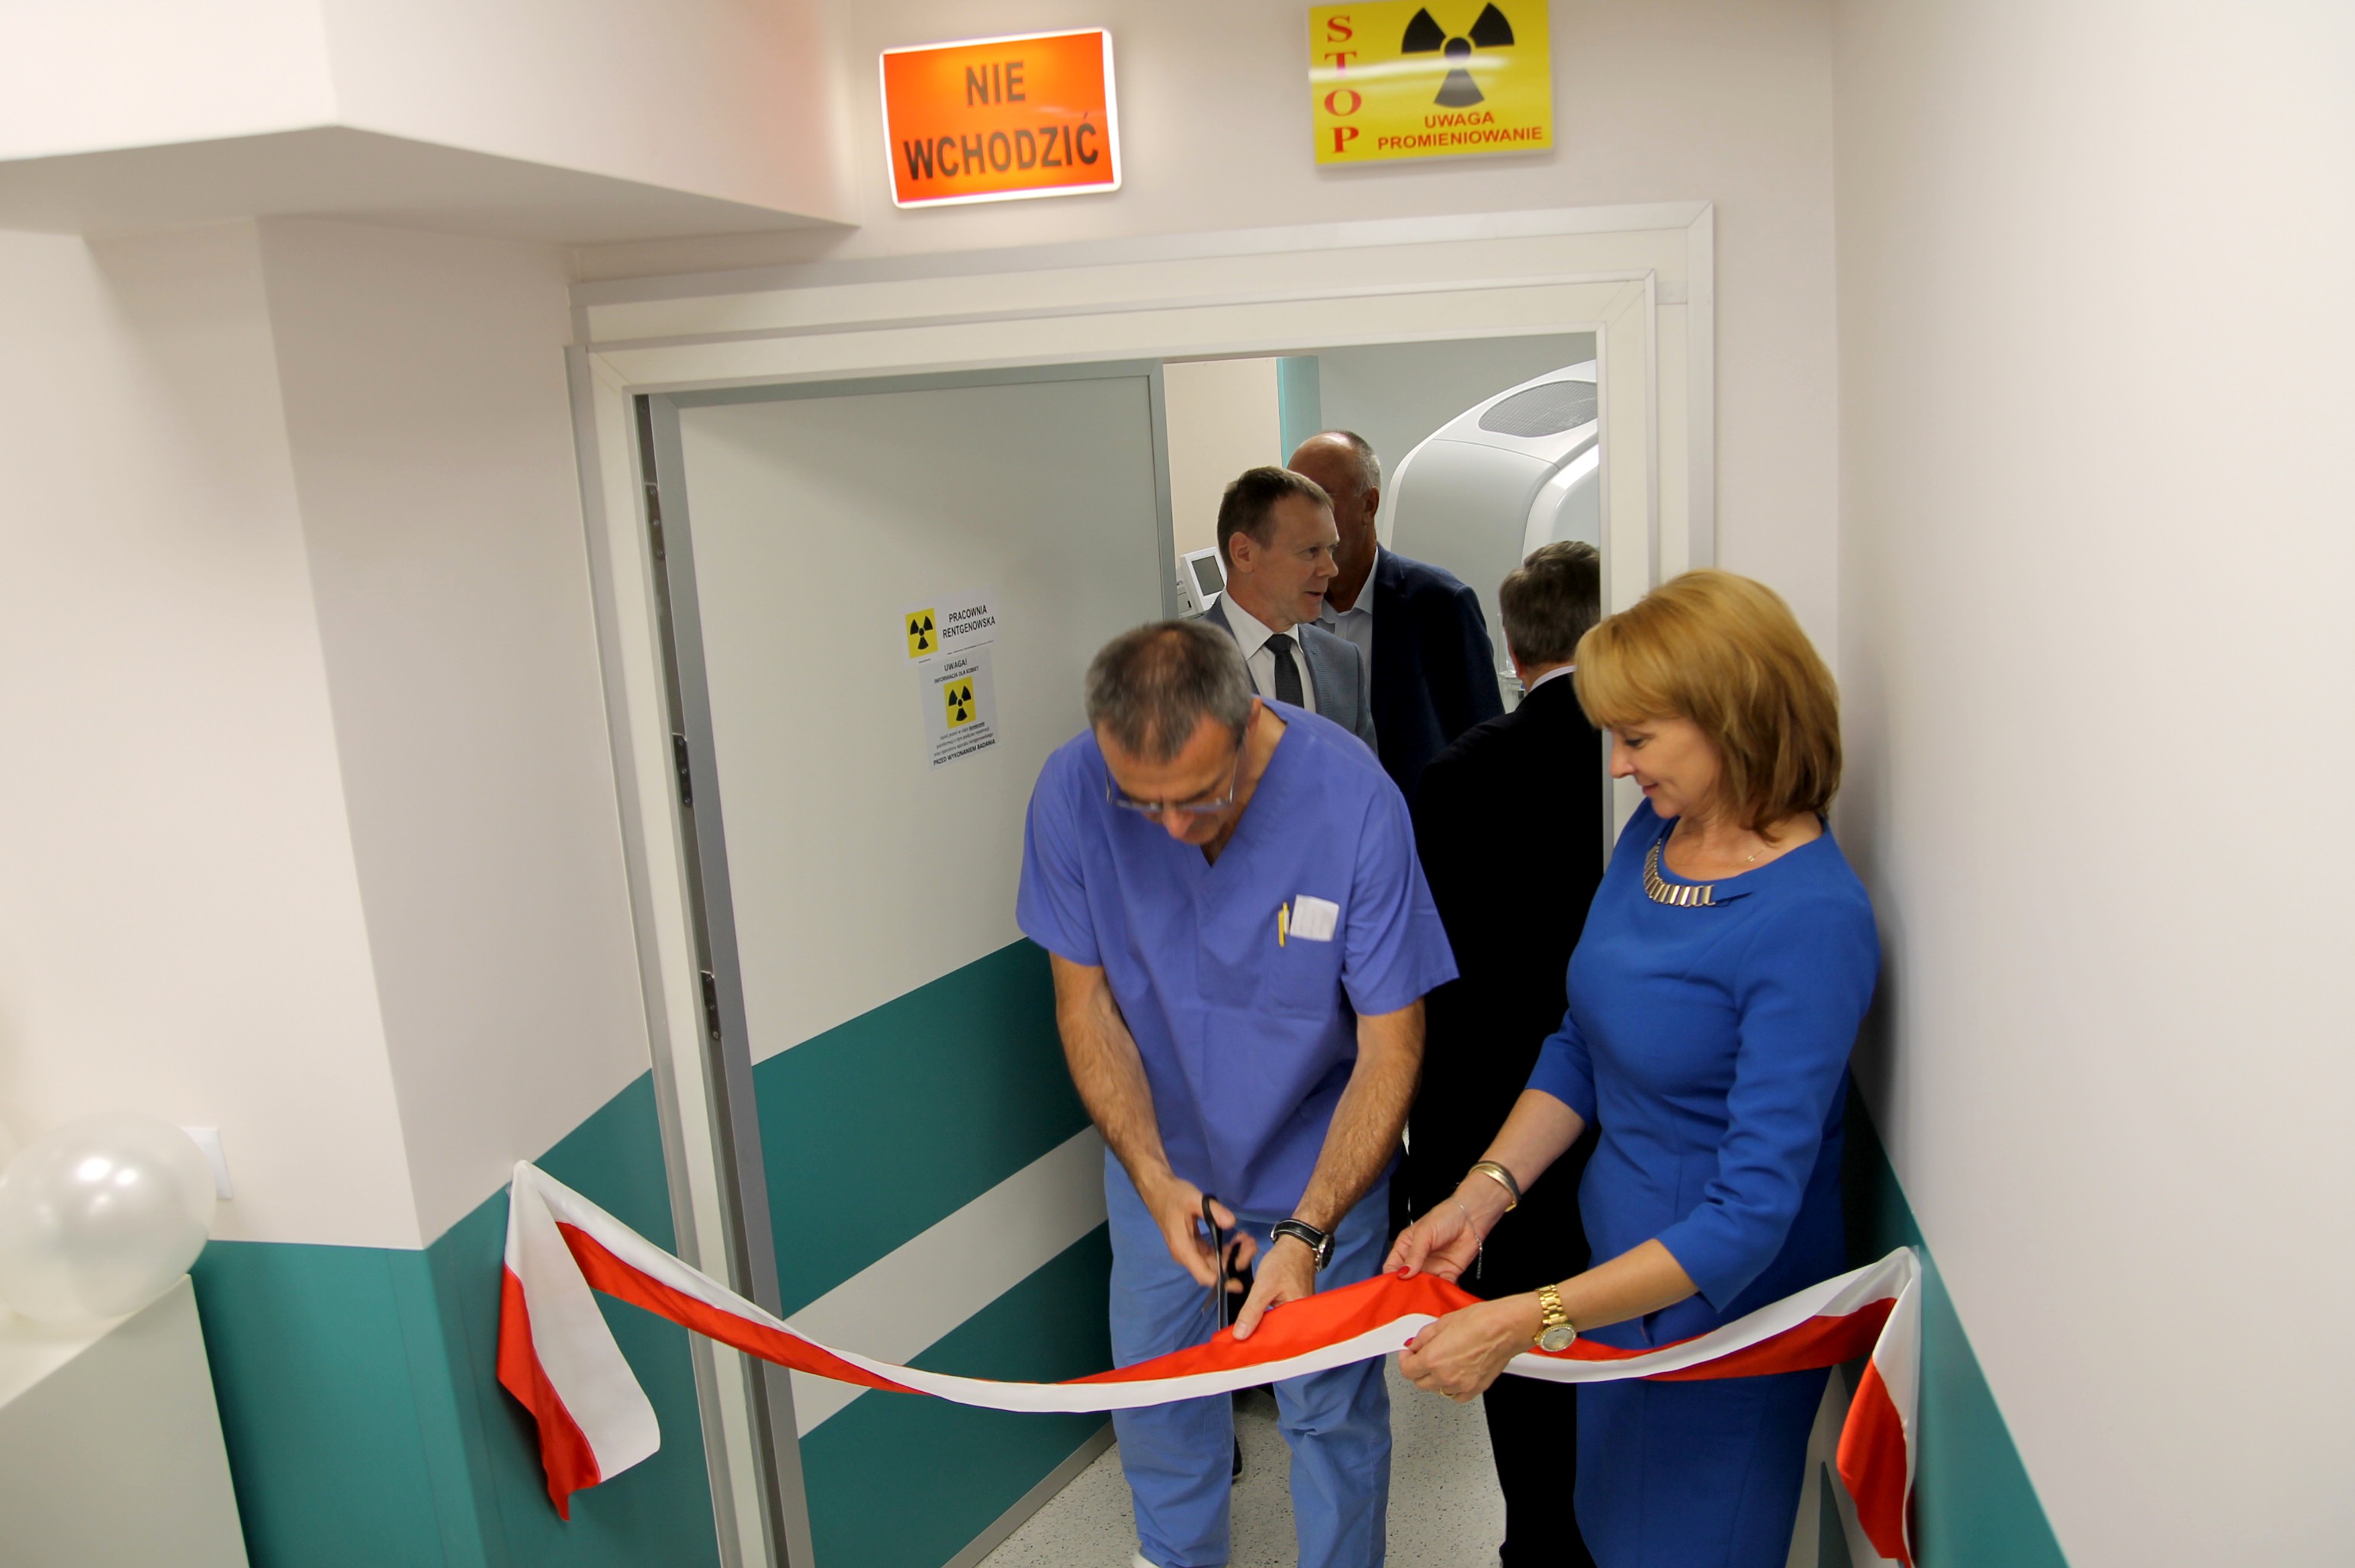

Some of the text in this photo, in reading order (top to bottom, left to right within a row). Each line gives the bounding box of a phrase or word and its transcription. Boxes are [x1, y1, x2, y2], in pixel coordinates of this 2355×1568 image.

[965, 61, 1026, 107] NIE
[1324, 15, 1362, 154] STOP
[1424, 111, 1495, 129] UWAGA
[903, 111, 1100, 181] WCHODZIĆ
[1377, 127, 1543, 150] PROMIENIOWANIE
[949, 605, 988, 622] PRACOWNIA
[943, 616, 996, 638] RENTGENOWSKA
[944, 658, 968, 671] UWAGA!
[933, 756, 947, 766] PRZED
